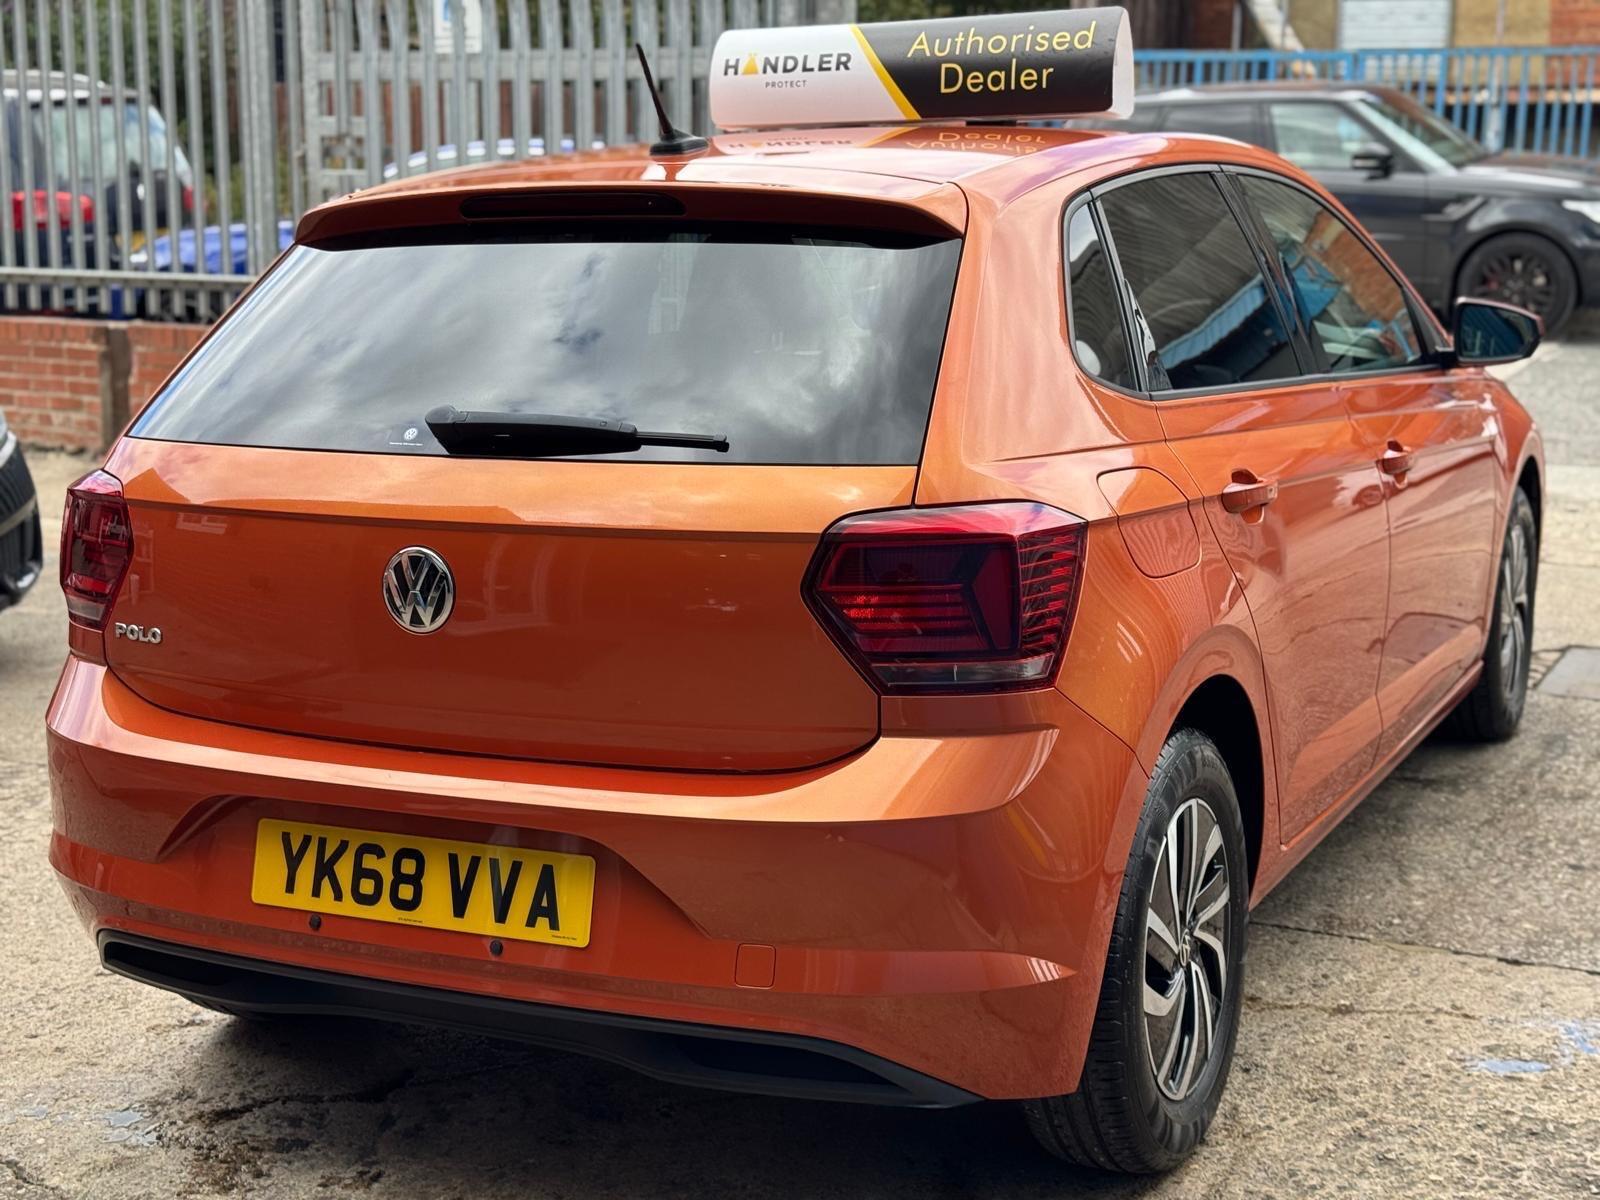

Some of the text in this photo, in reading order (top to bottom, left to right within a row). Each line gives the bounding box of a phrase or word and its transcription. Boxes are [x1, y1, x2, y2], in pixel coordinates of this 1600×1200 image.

[906, 20, 1097, 58] Authorised
[765, 79, 807, 88] PROTECT
[939, 58, 1054, 94] Dealer
[115, 622, 162, 644] POLO
[281, 831, 560, 932] YK68 VVA
